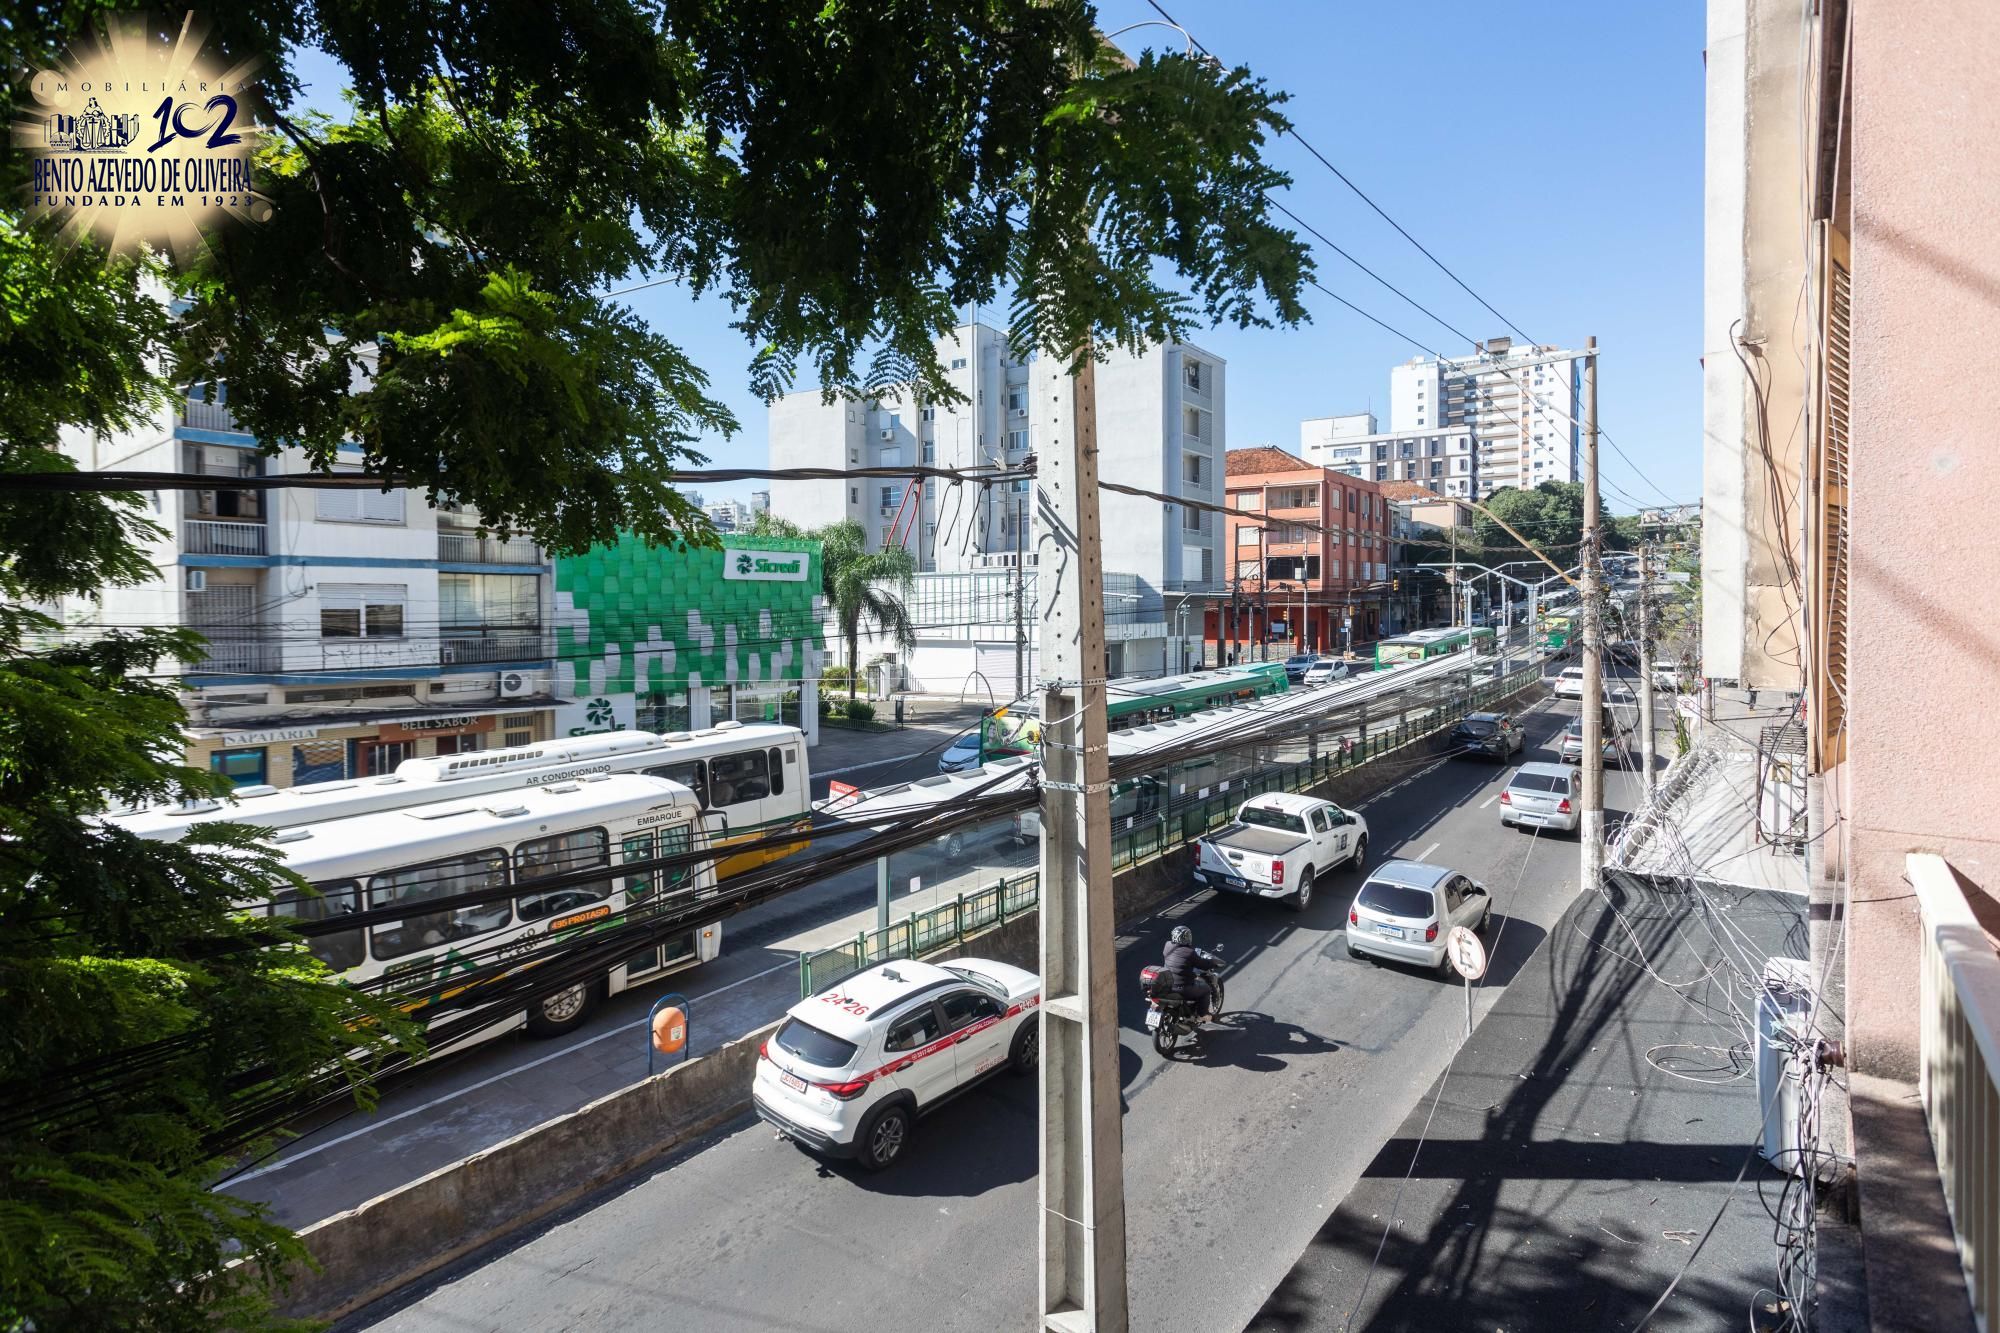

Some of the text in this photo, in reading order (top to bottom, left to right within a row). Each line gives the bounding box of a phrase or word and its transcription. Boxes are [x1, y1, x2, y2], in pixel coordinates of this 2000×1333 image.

[401, 716, 479, 731] BELL SABOR
[526, 764, 611, 785] AR CONDICIONADO
[637, 810, 683, 826] EMBARQUE
[821, 993, 870, 1016] 2426
